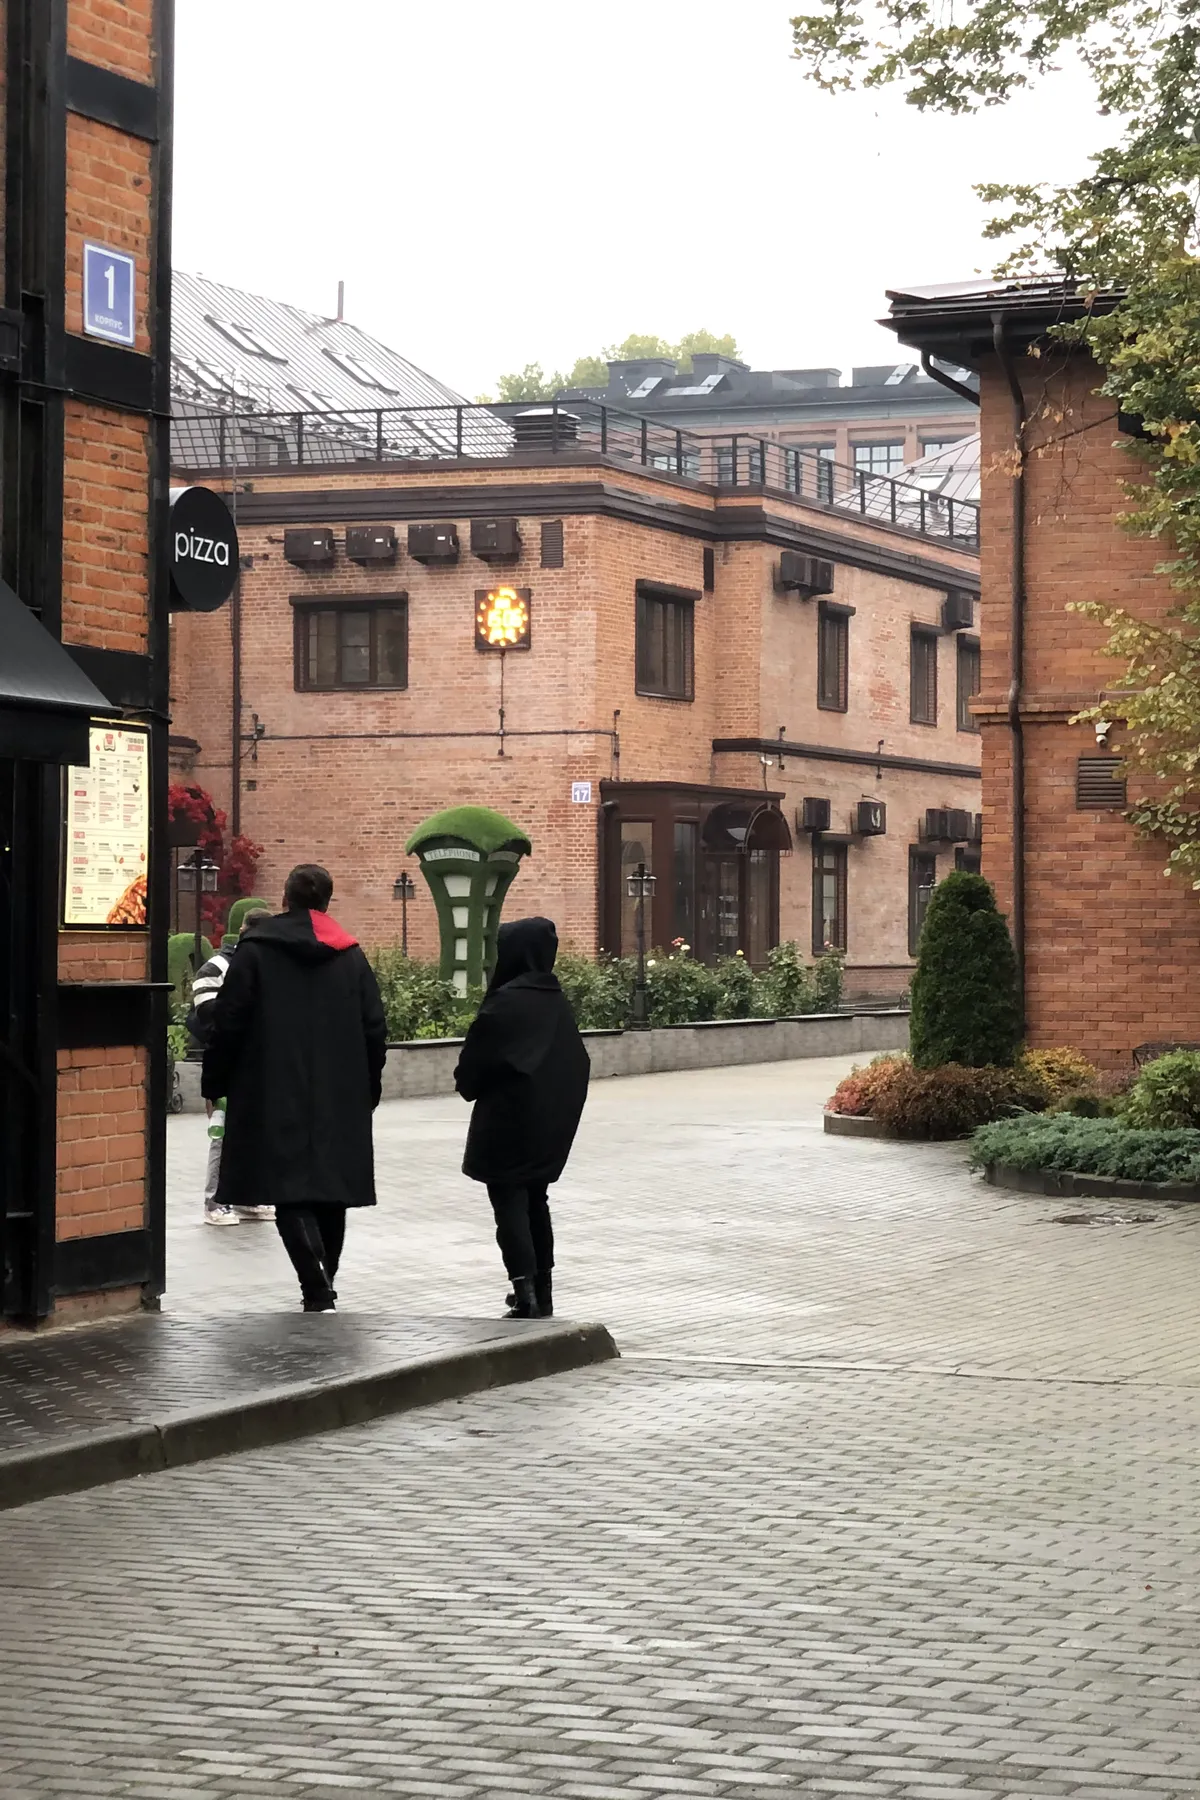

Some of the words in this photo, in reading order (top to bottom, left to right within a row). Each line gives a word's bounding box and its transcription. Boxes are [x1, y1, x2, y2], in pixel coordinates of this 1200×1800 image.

[104, 265, 114, 310] 1
[94, 313, 123, 331] КОРПУС
[174, 527, 229, 566] pizza
[574, 789, 589, 801] 17
[427, 848, 478, 860] TELEPHONE
